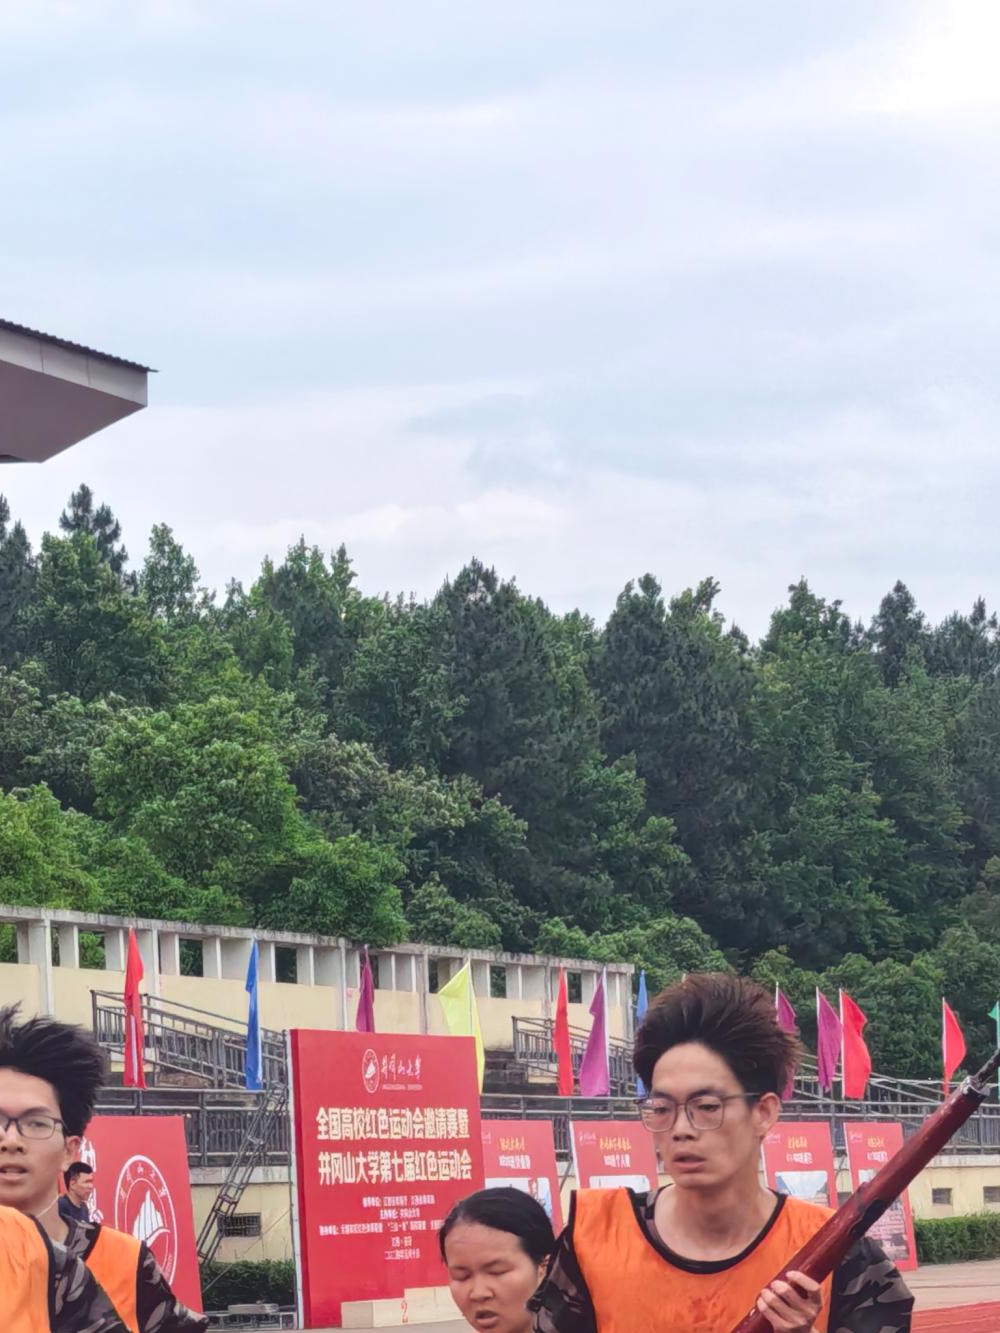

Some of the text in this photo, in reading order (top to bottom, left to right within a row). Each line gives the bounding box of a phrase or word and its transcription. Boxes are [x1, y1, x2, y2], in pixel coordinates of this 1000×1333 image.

[316, 1106, 471, 1141] 全国高校红色运动会邀请赛暨
[318, 1148, 473, 1186] 井冈山大学第七届红色运动会
[401, 1300, 409, 1324] 2
